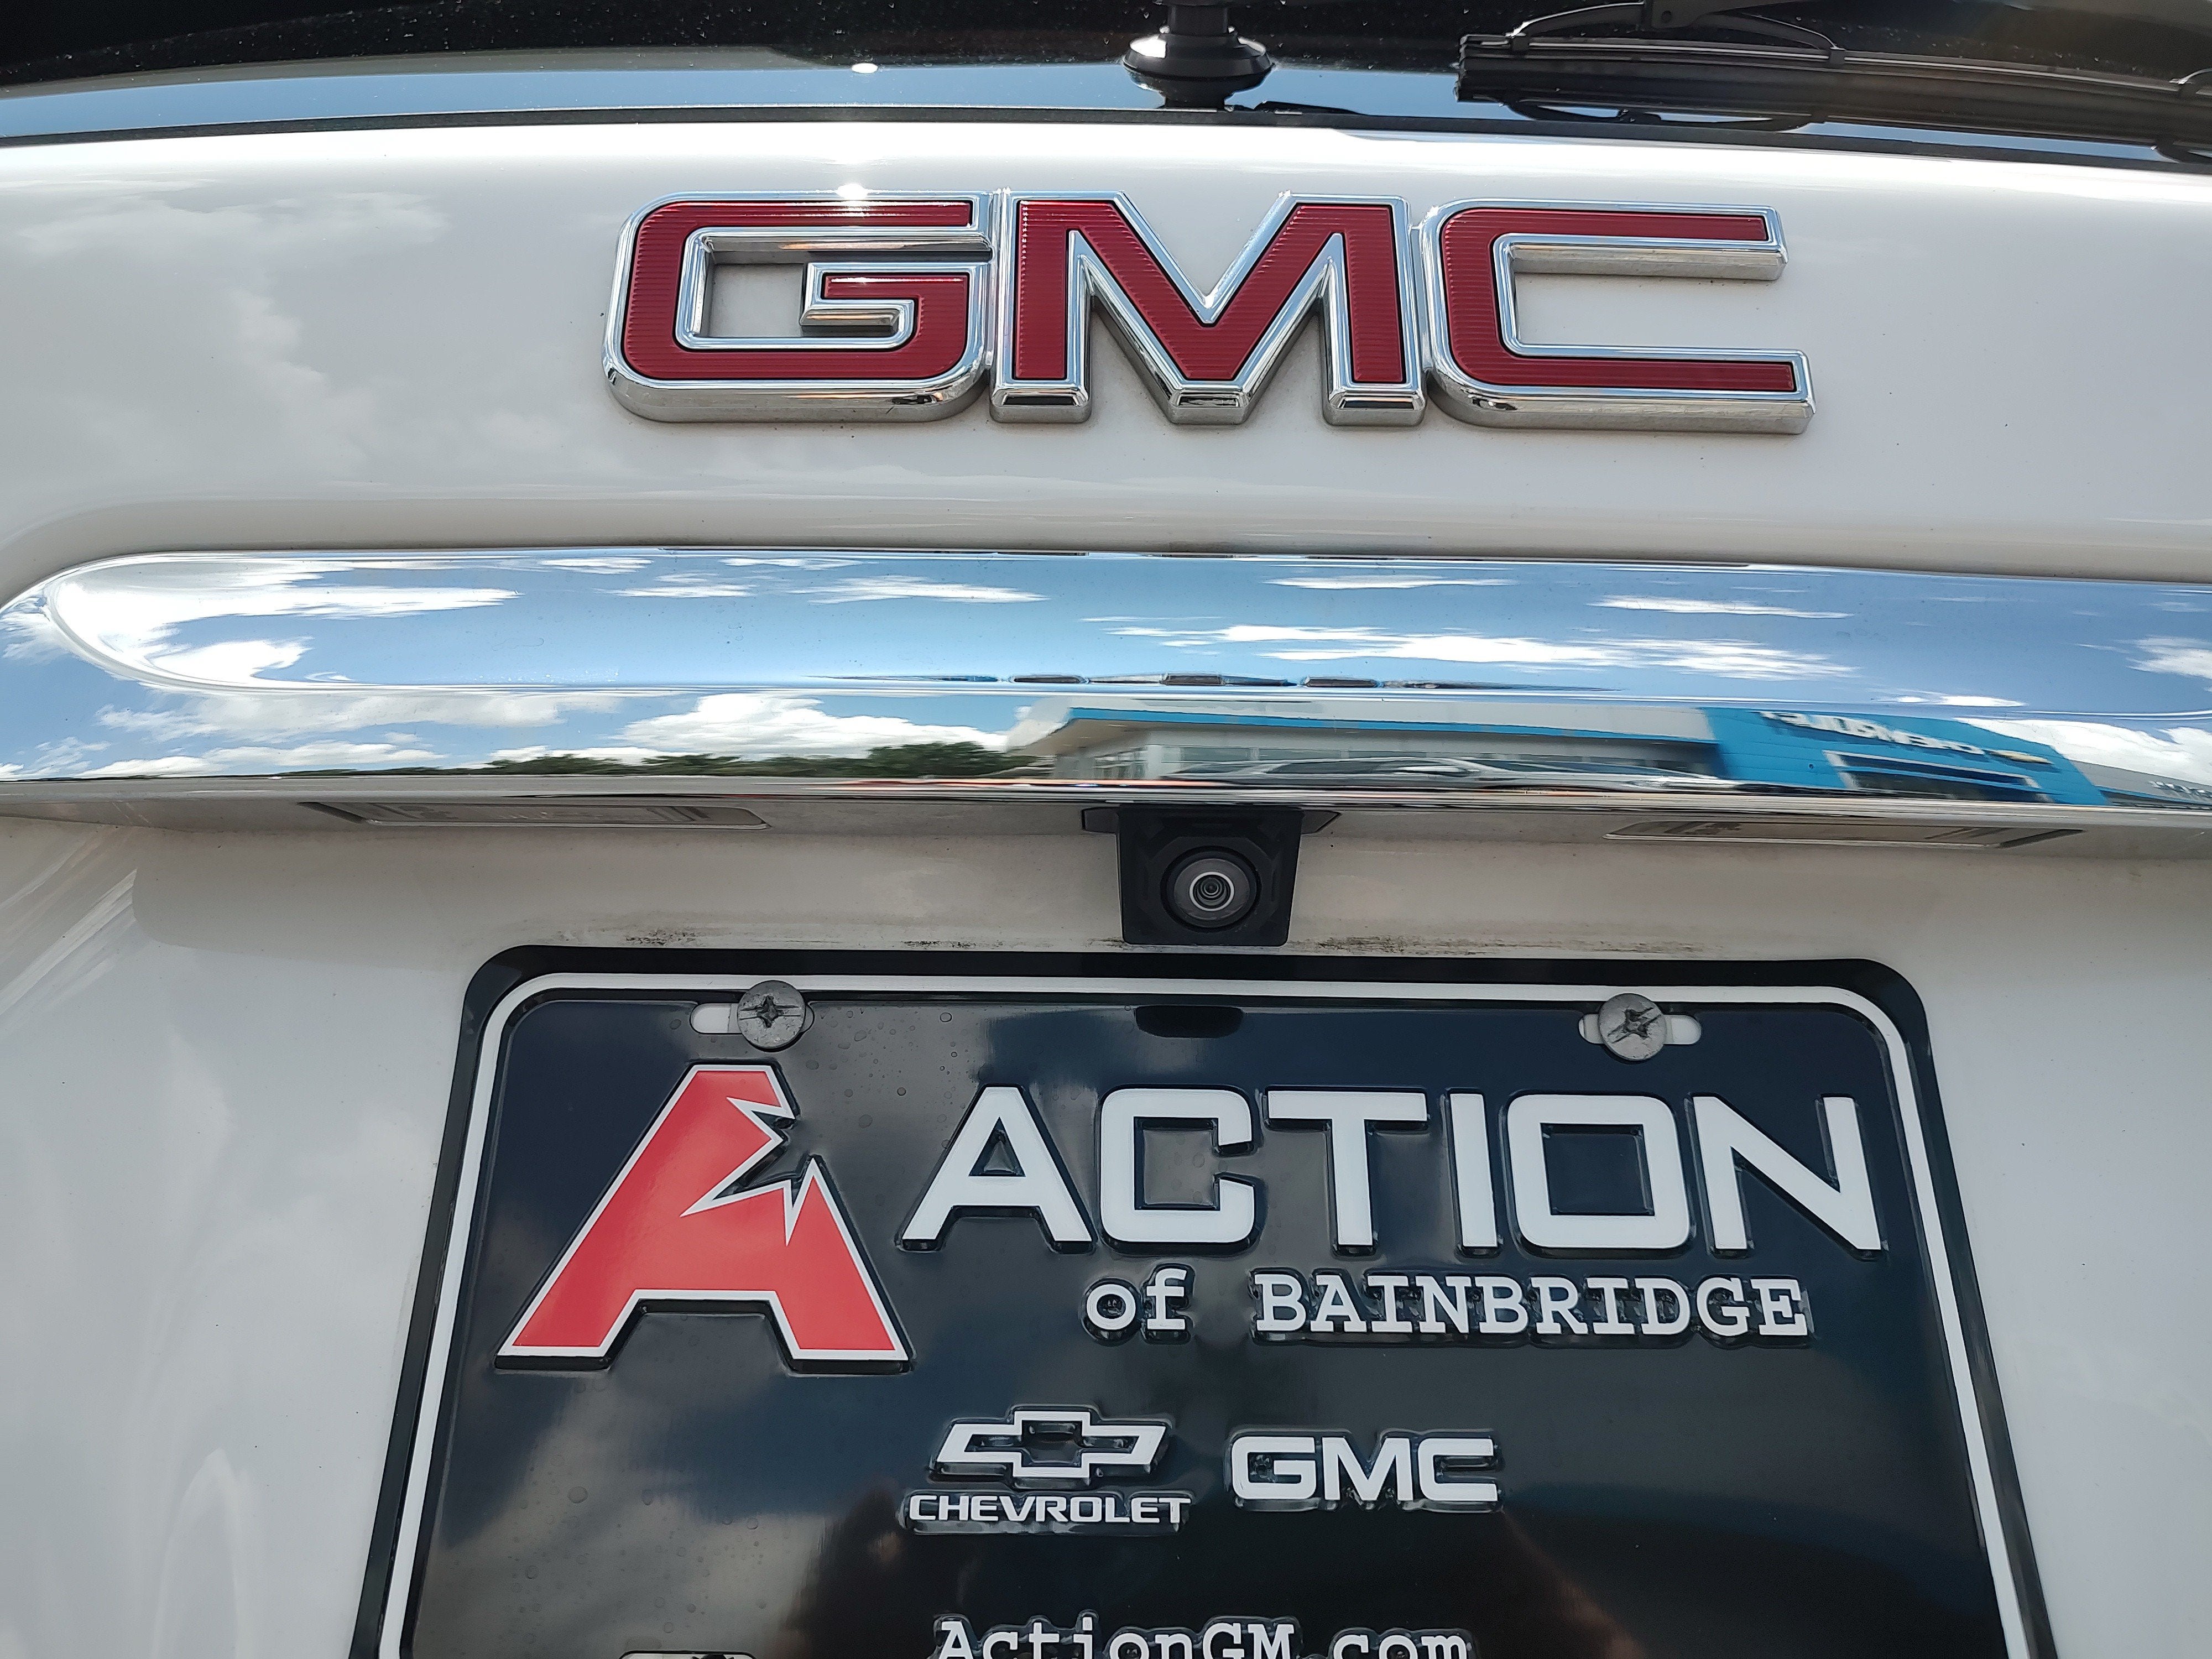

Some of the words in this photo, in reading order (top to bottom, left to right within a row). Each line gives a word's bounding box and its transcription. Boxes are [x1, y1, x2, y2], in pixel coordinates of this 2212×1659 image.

[603, 190, 1815, 435] GMC
[901, 1087, 1881, 1250] ACTION
[1086, 1268, 1187, 1331] of
[1254, 1274, 1808, 1337] BAINBRIDGE
[1232, 1436, 1498, 1501] GMC
[909, 1495, 1191, 1524] CHEVROLET
[938, 1616, 1467, 1659] ActionGMcom
